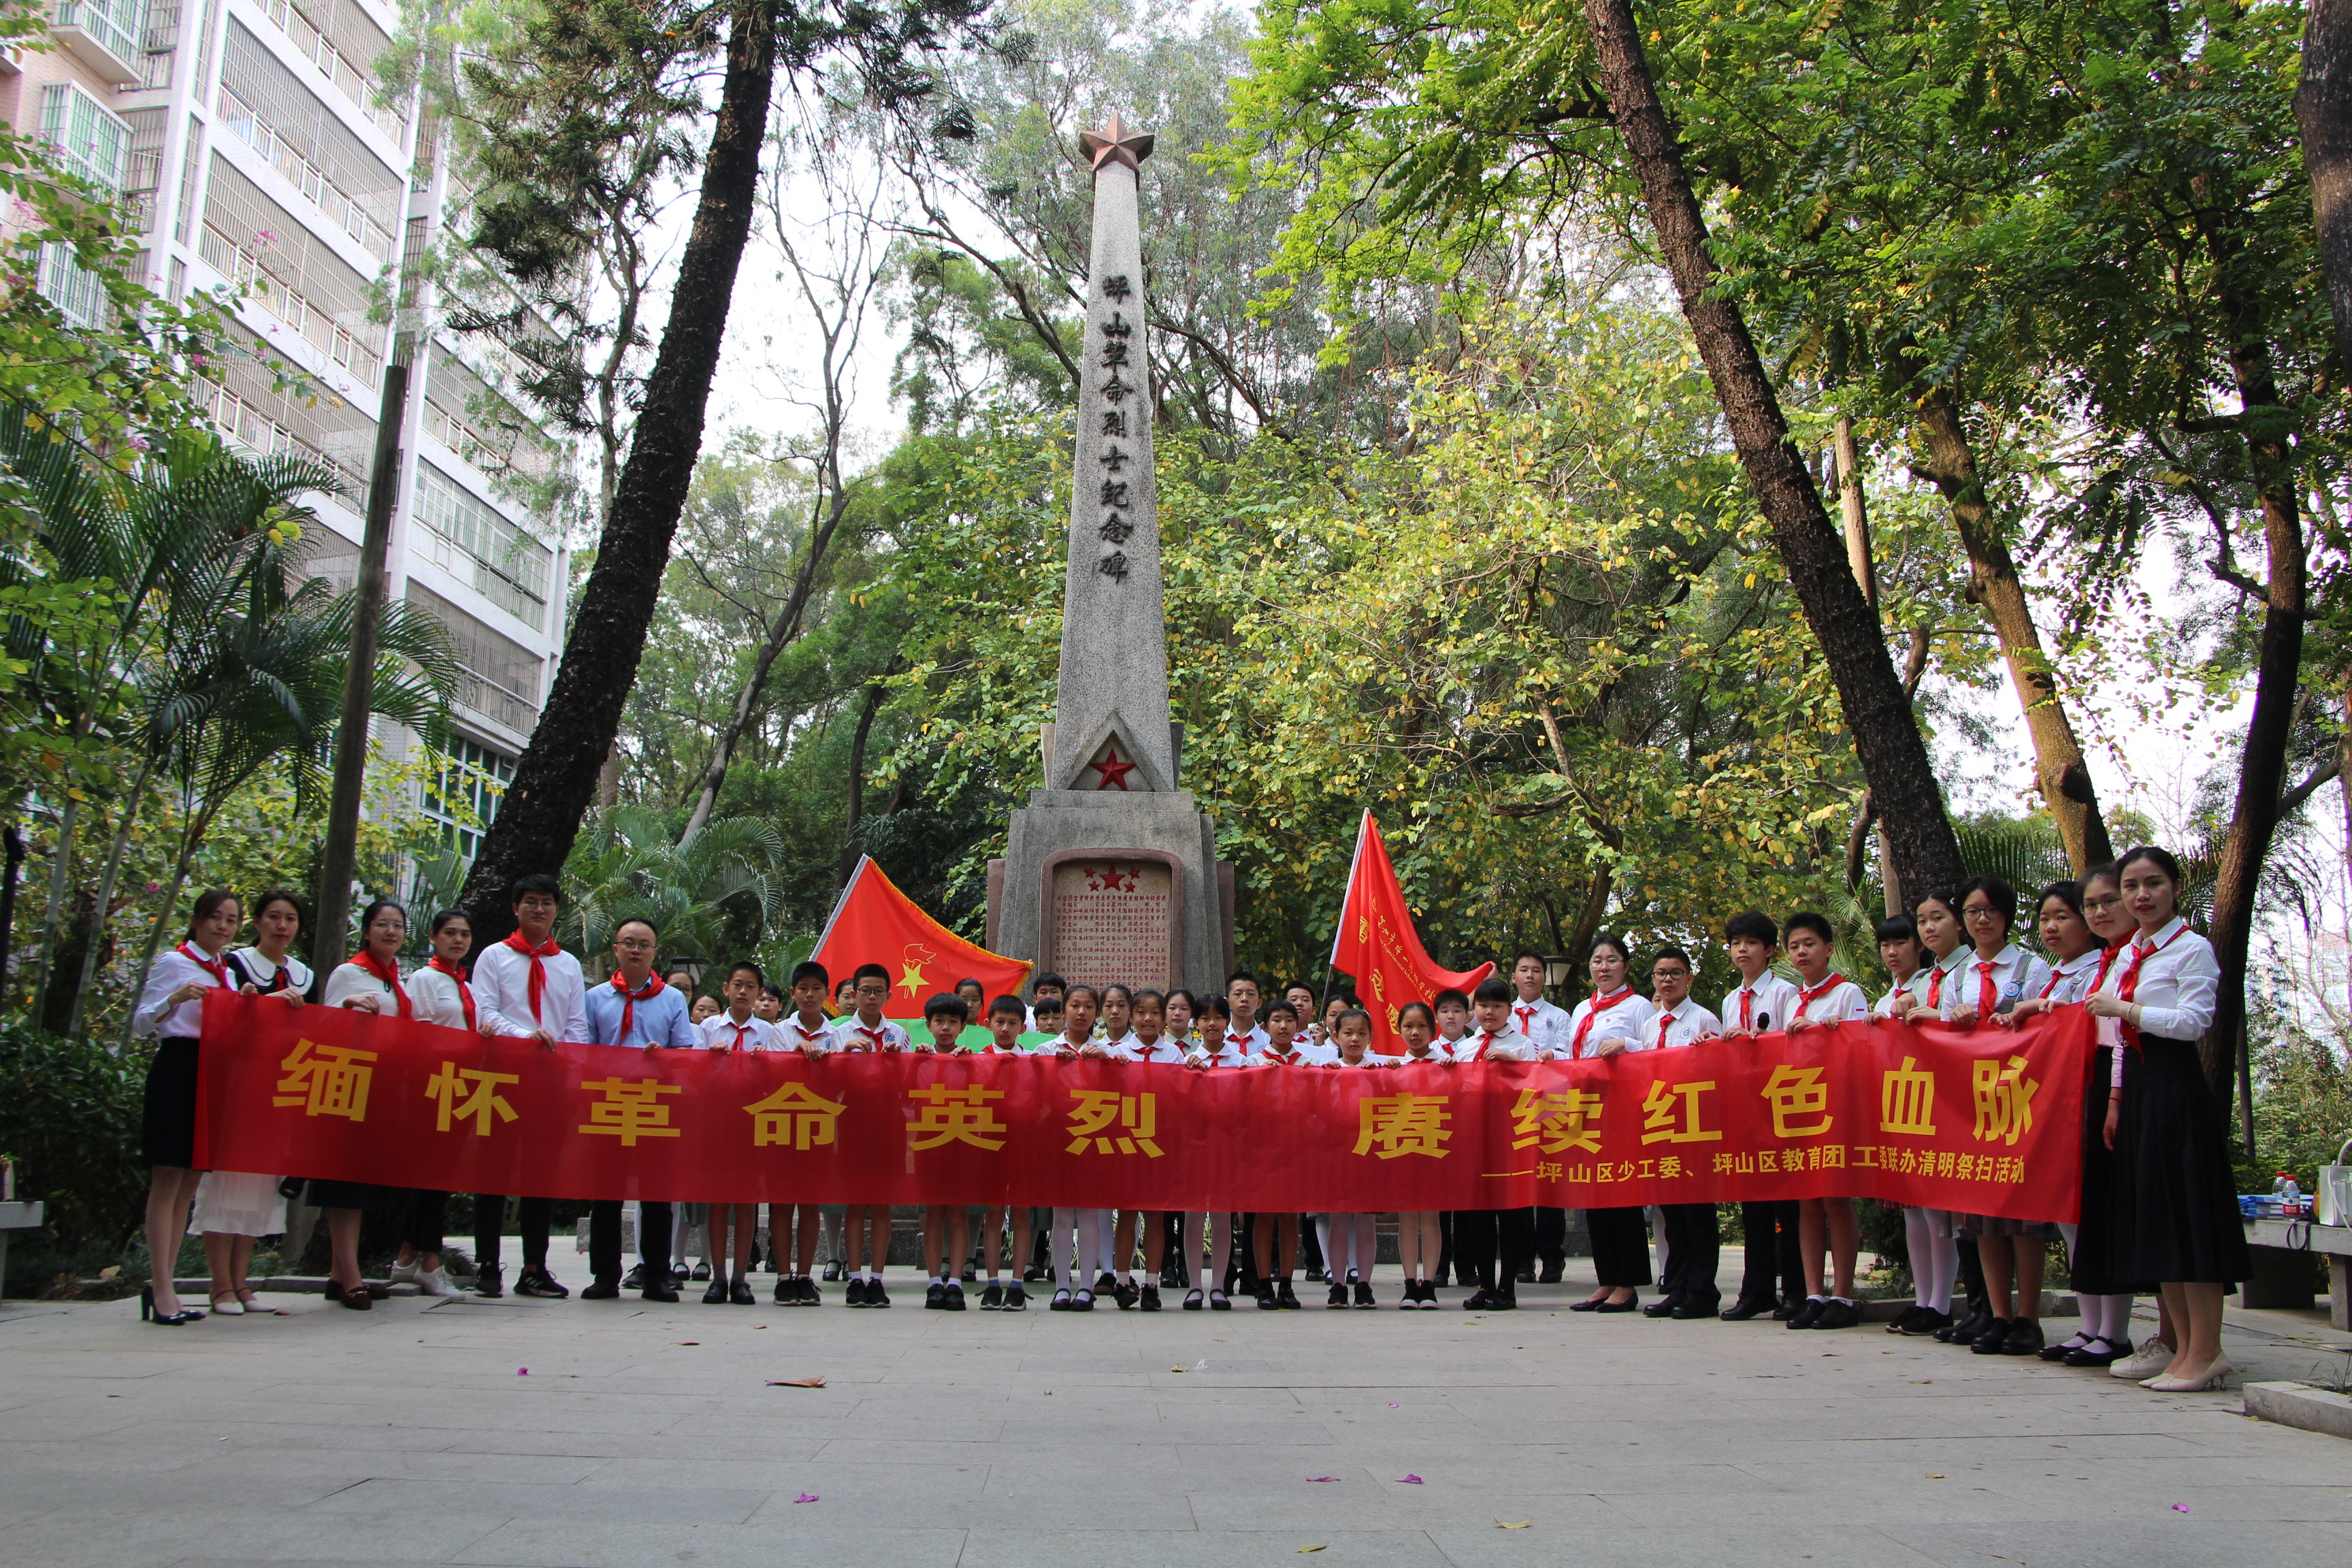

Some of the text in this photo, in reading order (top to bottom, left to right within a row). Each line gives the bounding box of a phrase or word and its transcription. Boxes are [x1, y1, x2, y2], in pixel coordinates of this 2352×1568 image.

[1098, 274, 1134, 584] 坪山革命烈士纪念碑
[272, 1037, 2040, 1159] 缅怀革命英烈 赓续红色血脉
